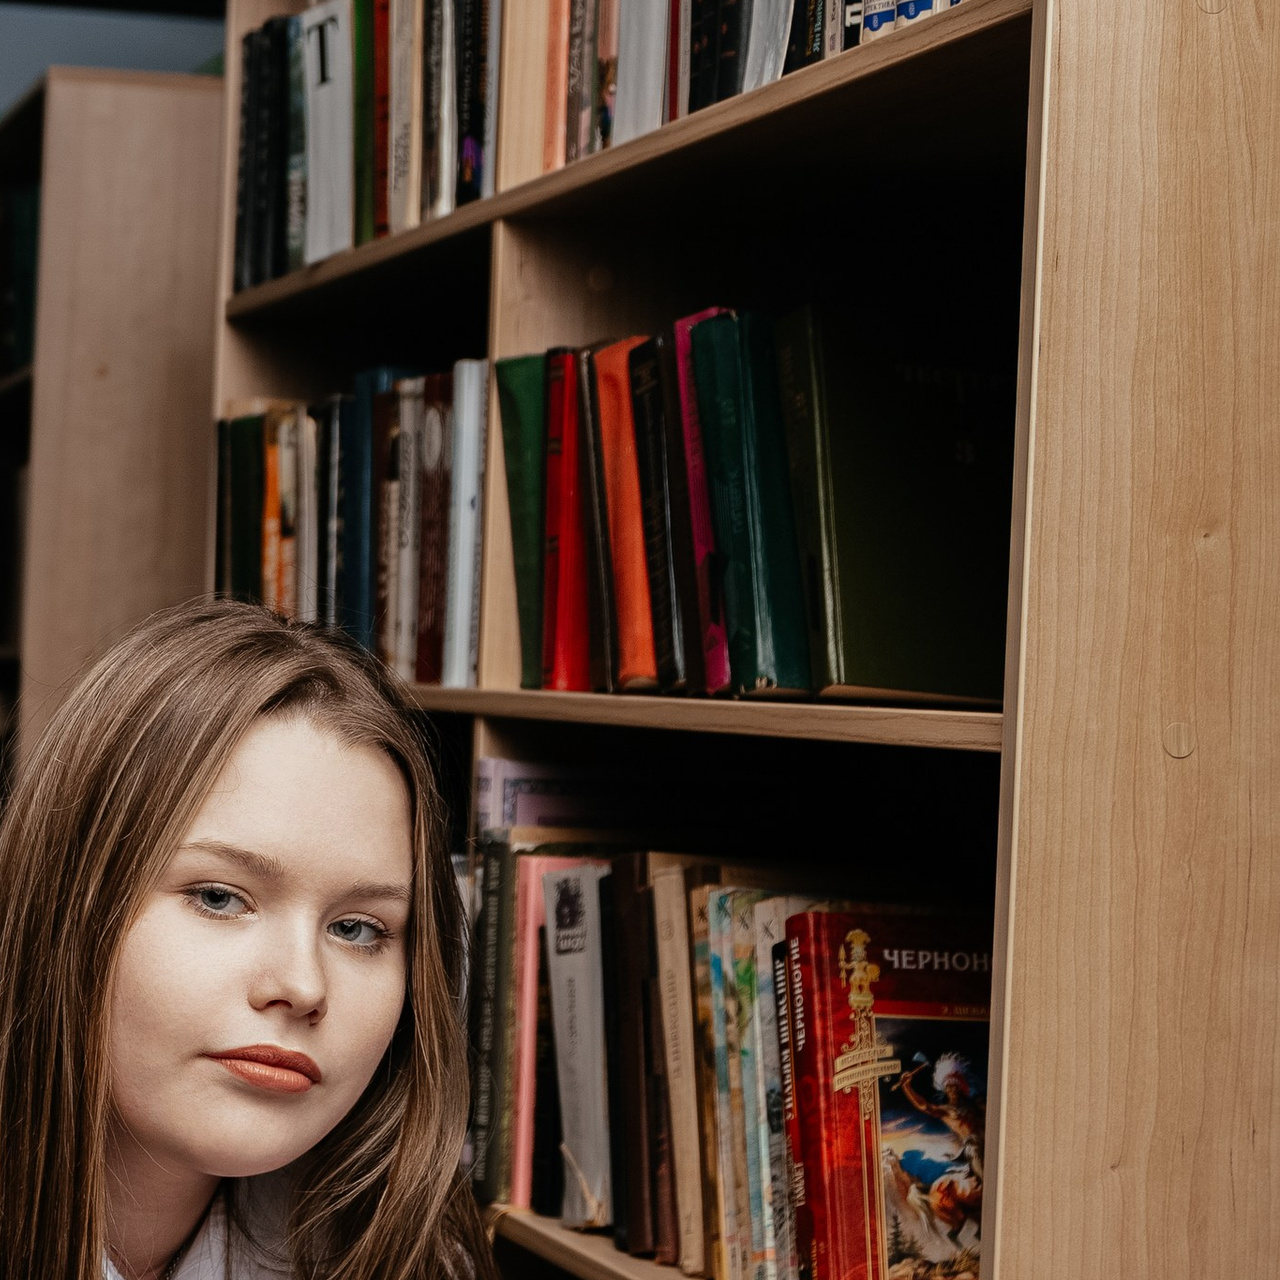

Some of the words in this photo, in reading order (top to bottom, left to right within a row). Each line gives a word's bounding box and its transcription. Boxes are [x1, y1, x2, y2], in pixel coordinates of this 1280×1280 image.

[306, 16, 339, 87] Т
[790, 936, 806, 1052] ЧЕРНОНОГИЕ
[882, 948, 991, 971] ЧЕРНОН
[775, 959, 790, 1045] ШЕКСПИР
[781, 1051, 796, 1121] УИЛЬЯМ
[793, 1161, 806, 1207] ГАМЛЕТ
